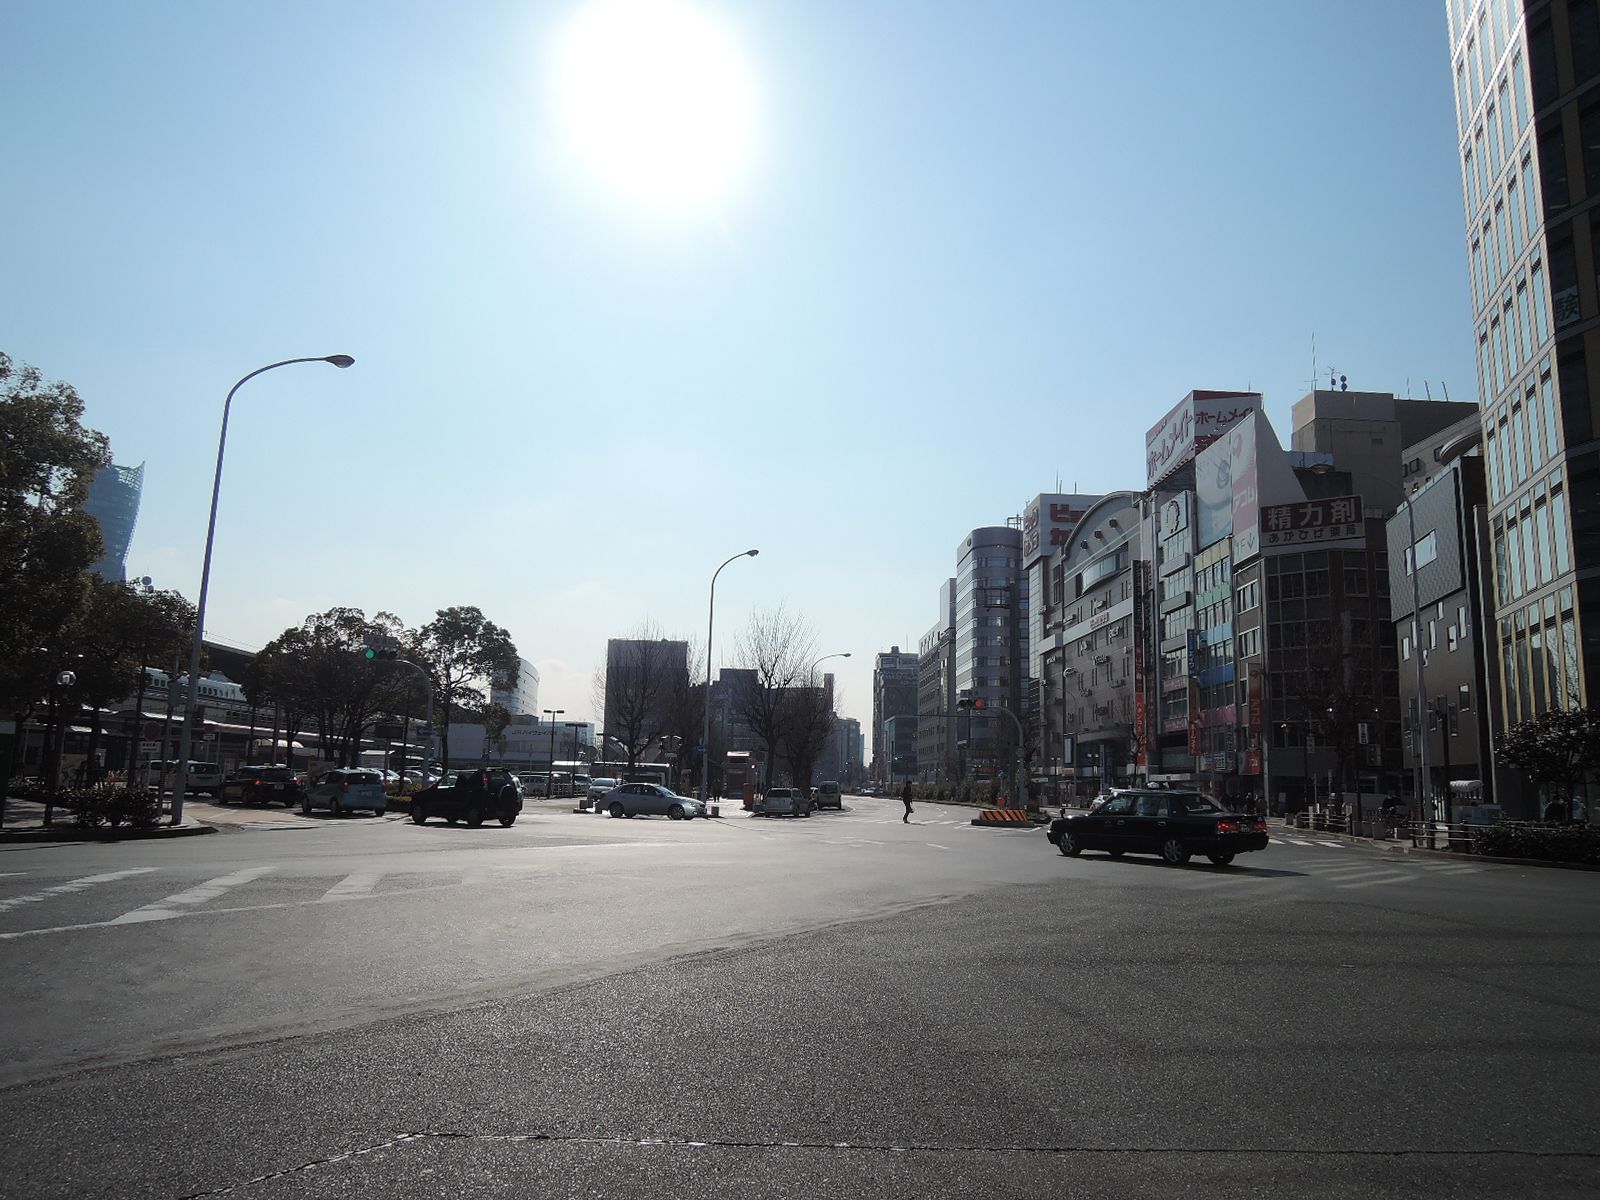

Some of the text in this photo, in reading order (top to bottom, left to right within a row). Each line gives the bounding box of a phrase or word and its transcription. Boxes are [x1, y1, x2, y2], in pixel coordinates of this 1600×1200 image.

[1195, 407, 1254, 425] ホームメイ
[1267, 498, 1356, 530] 精力剤
